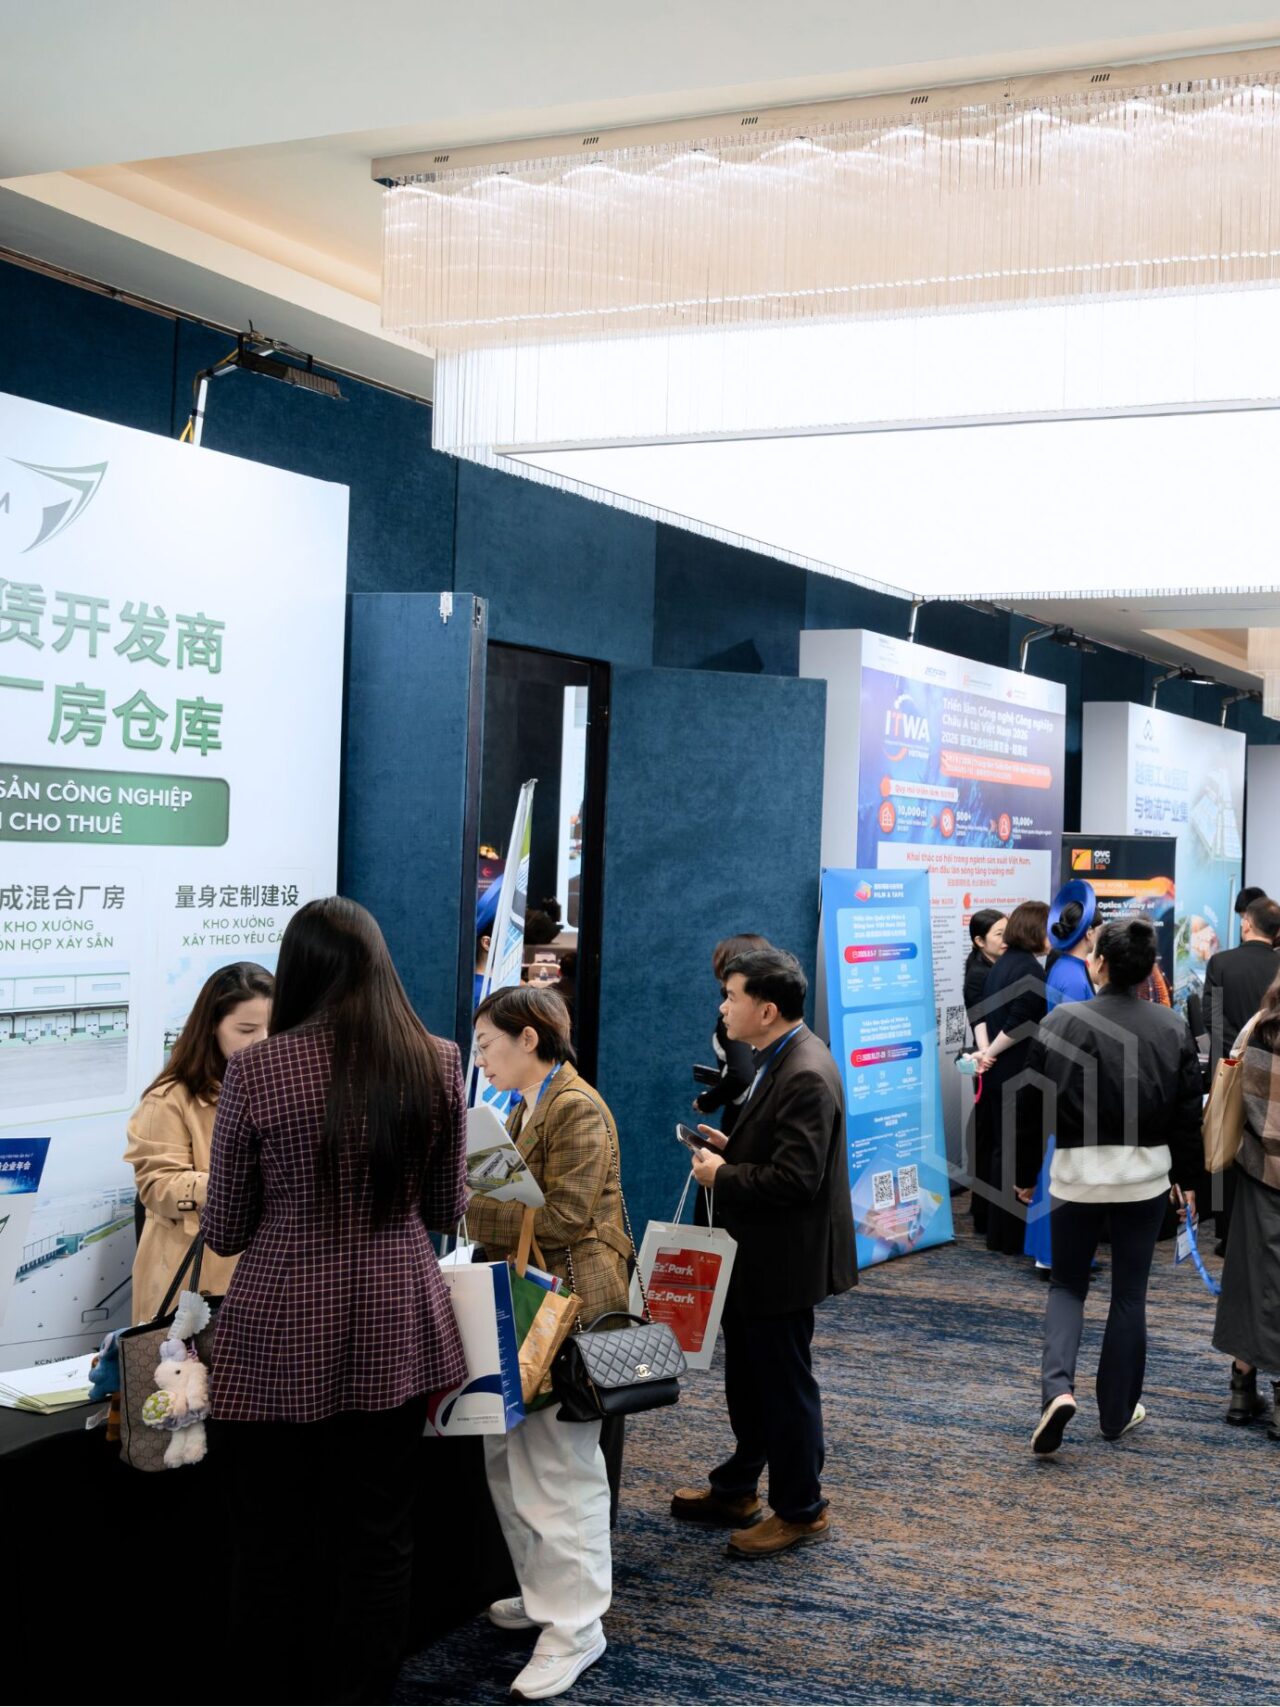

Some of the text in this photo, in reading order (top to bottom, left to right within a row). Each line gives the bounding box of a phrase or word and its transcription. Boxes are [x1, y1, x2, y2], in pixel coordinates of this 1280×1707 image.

[884, 709, 930, 743] ITWA
[46, 780, 112, 804] CÔNG
[118, 786, 193, 812] NGHIỆP
[9, 812, 123, 834] CHO THUÊ
[0, 884, 125, 911] 成混合厂房
[175, 884, 299, 908] 量身定制建设
[1098, 900, 1121, 910] Optics
[1123, 901, 1145, 911] Valley
[4, 920, 37, 933] KHO
[203, 918, 230, 930] KHO
[209, 934, 240, 945] THEO
[244, 930, 265, 944] YÊU
